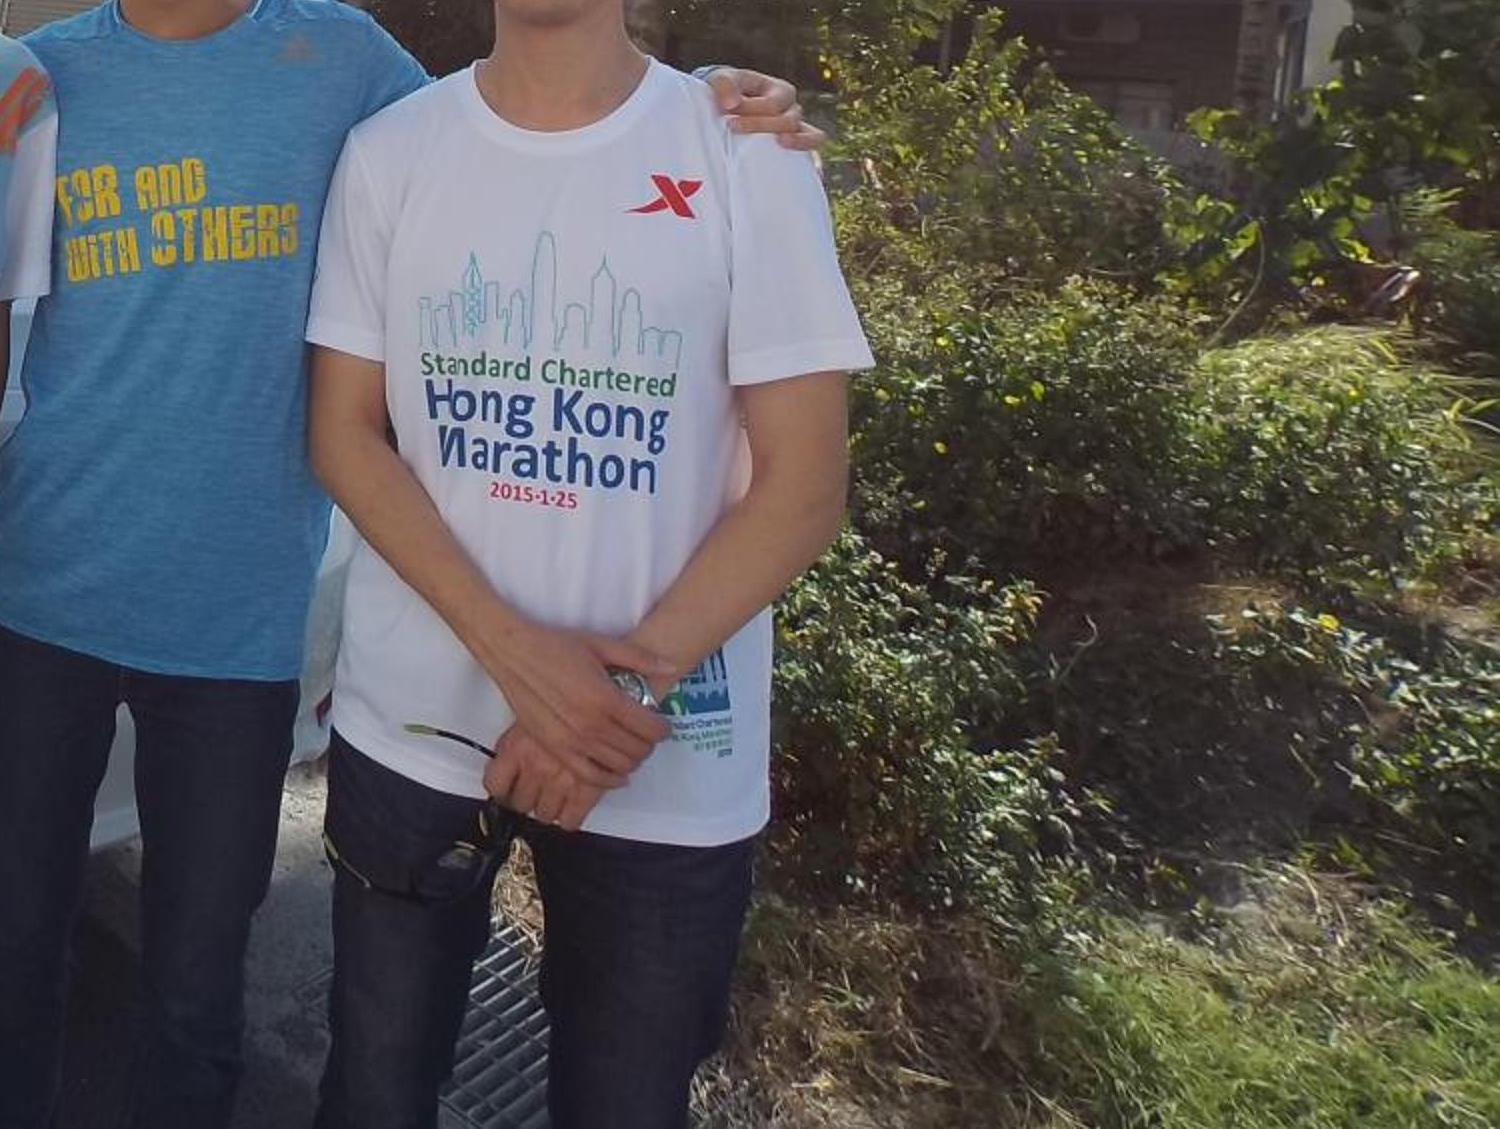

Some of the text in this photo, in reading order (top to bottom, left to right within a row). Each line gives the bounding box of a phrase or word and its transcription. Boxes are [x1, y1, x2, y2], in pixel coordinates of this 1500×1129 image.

[151, 203, 297, 266] OTHERS
[421, 351, 677, 397] Standard Chartered
[425, 378, 669, 455] Hong Kong
